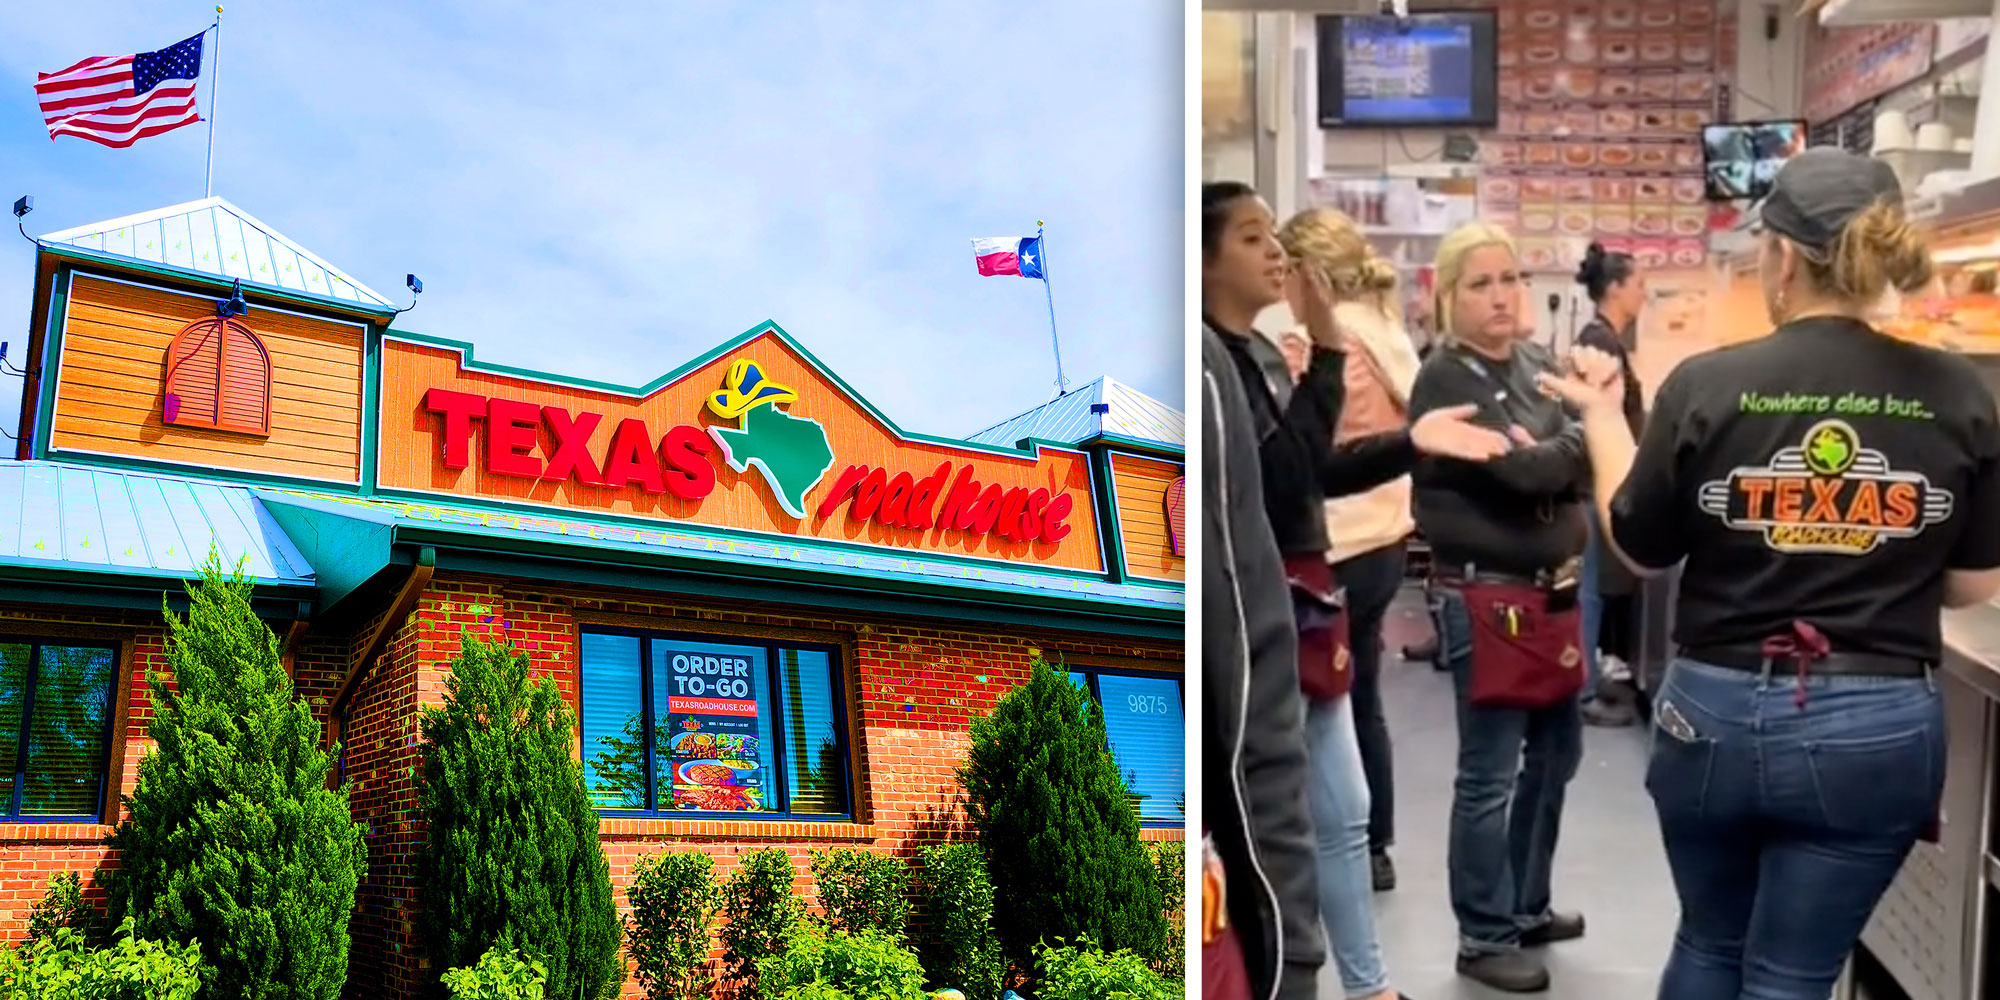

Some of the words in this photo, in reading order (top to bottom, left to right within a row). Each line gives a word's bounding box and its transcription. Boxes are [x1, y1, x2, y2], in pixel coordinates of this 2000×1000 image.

[1740, 392, 1830, 412] Nowhere
[1834, 392, 1880, 413] else
[426, 388, 716, 500] TEXAS
[1740, 477, 1918, 527] TEXAS
[672, 654, 748, 677] ORDER
[674, 675, 749, 698] TO-GO
[670, 700, 756, 712] TEXASROADHOUSE.COM
[1128, 694, 1168, 714] 9875
